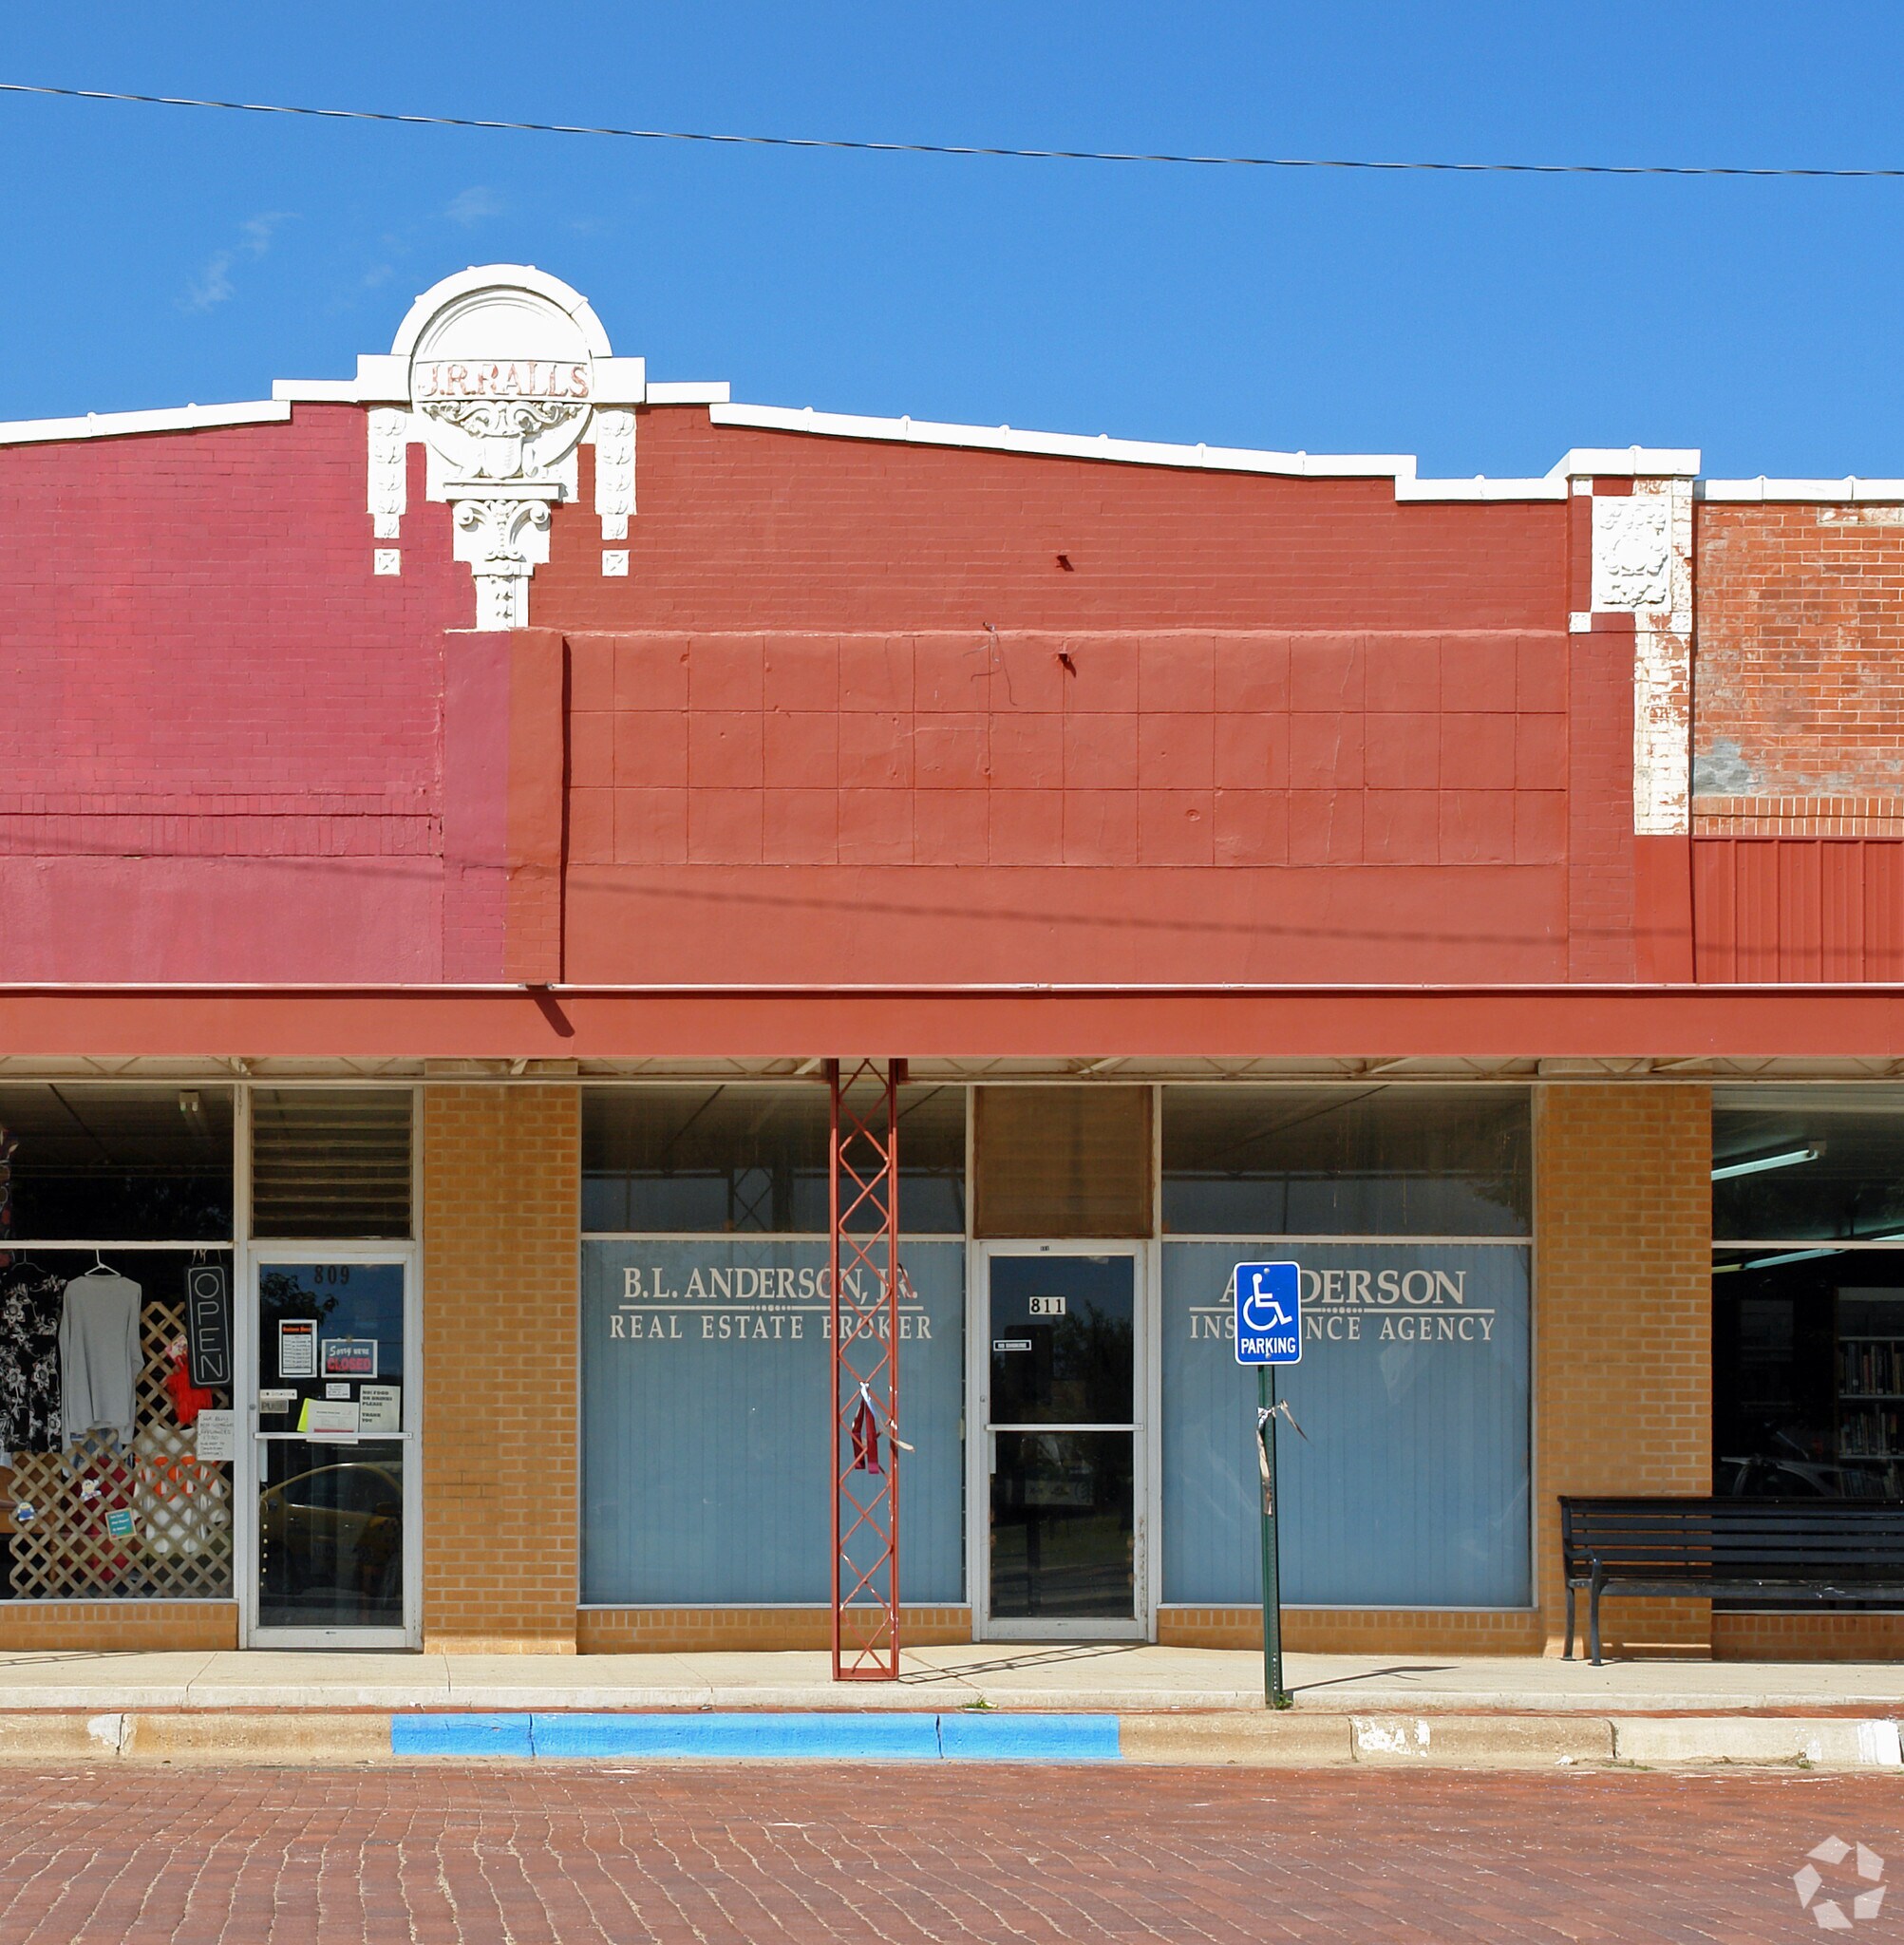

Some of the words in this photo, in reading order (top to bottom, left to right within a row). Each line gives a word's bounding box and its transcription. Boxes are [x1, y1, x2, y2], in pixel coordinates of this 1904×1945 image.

[314, 1265, 349, 1285] 809
[1030, 1297, 1063, 1313] 811
[194, 1273, 223, 1379] OPEN
[610, 1315, 683, 1339] REAL
[702, 1315, 803, 1339] ESTATE
[1190, 1315, 1361, 1340] INSNCE
[1380, 1316, 1495, 1341] AGENCY
[1240, 1337, 1296, 1355] PARKING
[328, 1357, 371, 1371] CLOSED
